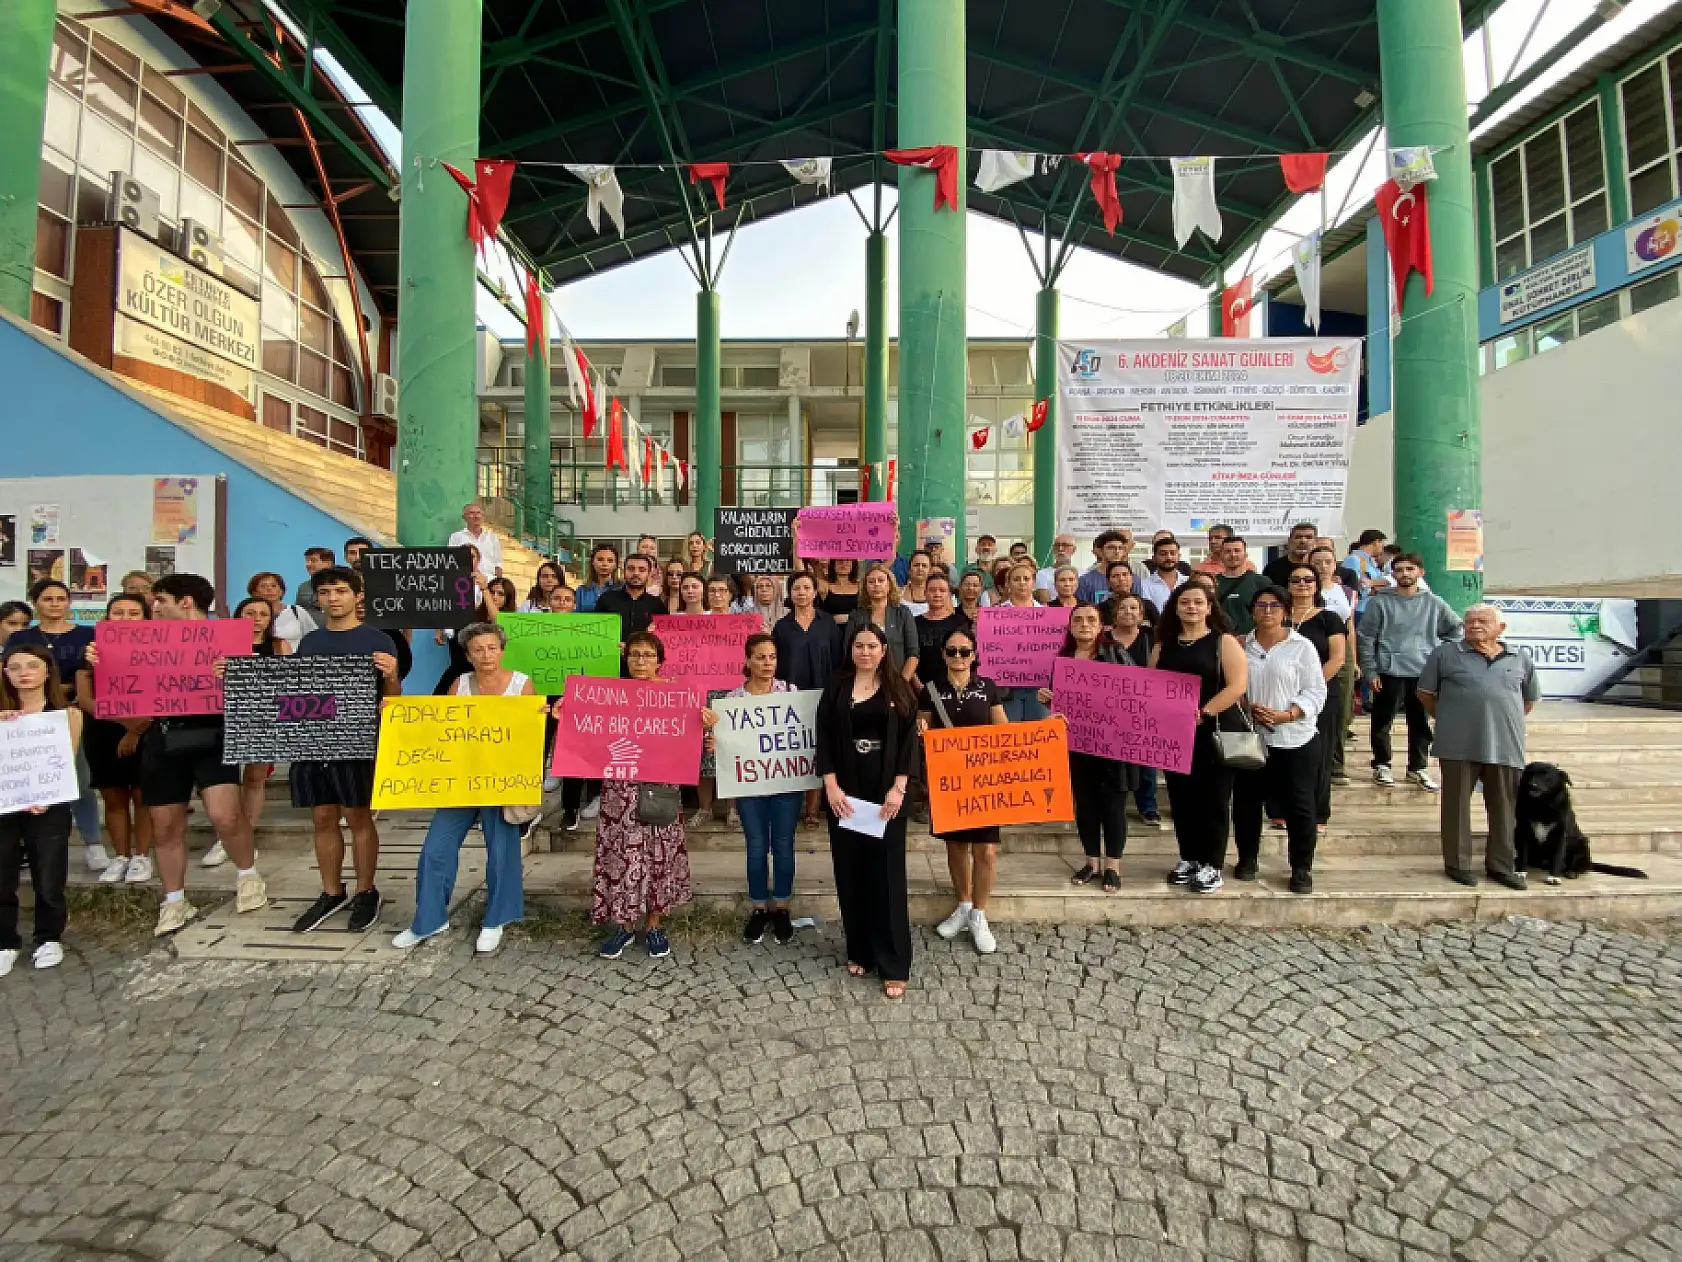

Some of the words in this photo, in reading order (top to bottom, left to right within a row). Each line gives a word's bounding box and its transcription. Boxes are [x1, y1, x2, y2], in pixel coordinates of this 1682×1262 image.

[143, 270, 187, 311] ÖZER
[194, 300, 244, 338] OLGUN
[127, 289, 190, 333] KÜLTÜR
[195, 322, 255, 363] MERKEZİ
[1118, 354, 1129, 368] 6.
[1133, 349, 1188, 368] AKDENİZ
[1192, 353, 1236, 369] SANAT
[1240, 349, 1295, 367] GÜNLERİ
[1140, 402, 1191, 411] FETHİYE
[1193, 401, 1274, 411] ETKİNLİKLERİ
[720, 510, 787, 525] KALANLARIN
[720, 542, 780, 556] BORCUDUR
[364, 553, 402, 569] TEK
[405, 552, 459, 570] ADAMA
[395, 573, 444, 593] KARŞI
[372, 597, 405, 617] ÇOK
[415, 597, 451, 612] KADIN
[108, 675, 143, 695] KIZ
[1064, 665, 1153, 699] RASTGELE
[1166, 678, 1194, 701] BİR
[153, 697, 189, 713] SIKI
[277, 695, 337, 721] 2024
[573, 683, 629, 707] KADINA
[636, 685, 700, 712] ŞİDDETİN
[1056, 688, 1092, 709] YERE
[389, 704, 477, 723] ADALET
[725, 704, 801, 730] YASTA
[438, 726, 511, 743] SARAYI
[573, 713, 604, 735] VAR
[609, 713, 630, 736] BİR
[634, 713, 687, 741] ÇARESİ
[1131, 714, 1158, 735] BİR
[758, 725, 817, 753] DEĞİL
[932, 726, 1059, 753] UMUTSUZLUĞA
[965, 748, 1039, 769] KAPILIRSAN
[1075, 735, 1114, 757] DENK
[1121, 746, 1182, 768] GELECEK
[603, 765, 639, 779] CHP
[379, 777, 457, 798] ADALET
[939, 775, 961, 792] BU
[956, 790, 1035, 817] HATIRLA
